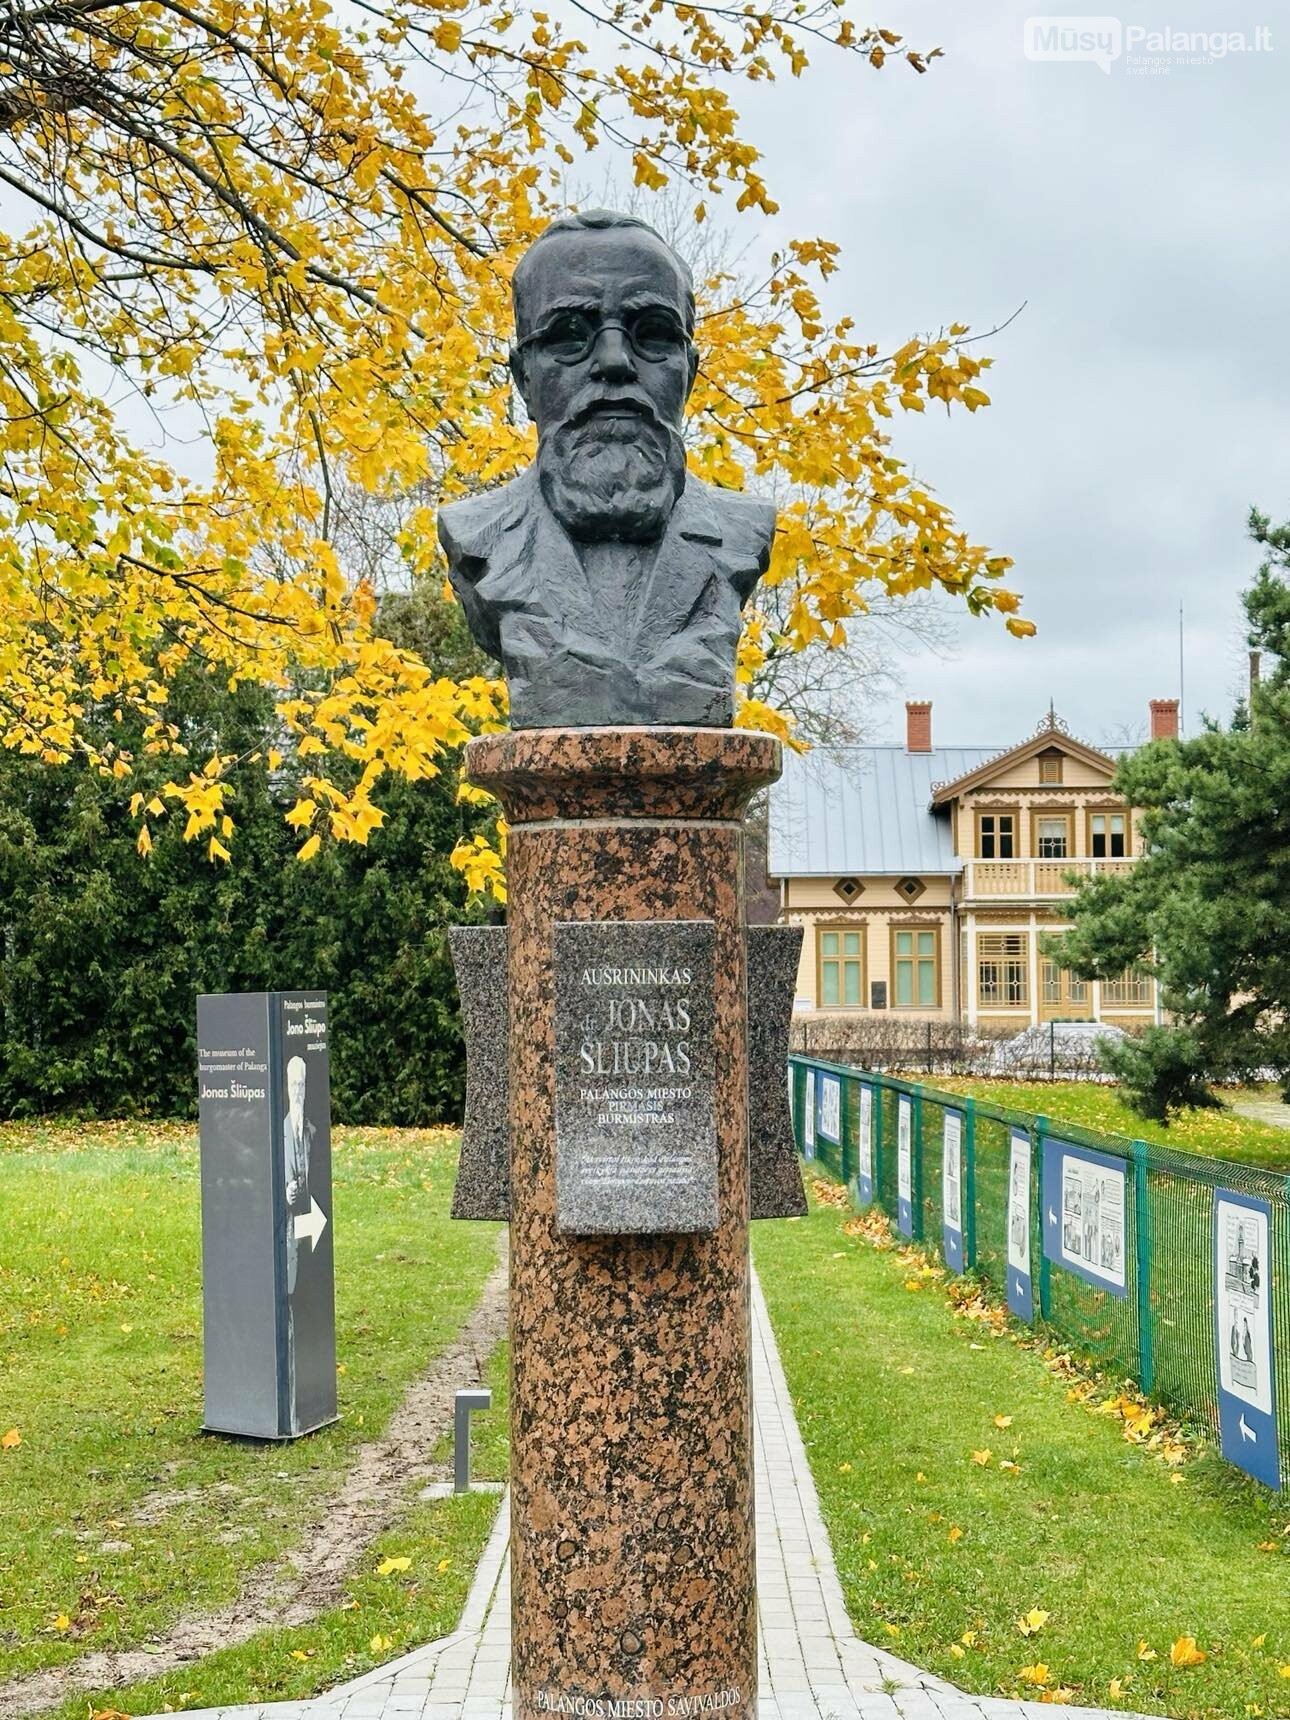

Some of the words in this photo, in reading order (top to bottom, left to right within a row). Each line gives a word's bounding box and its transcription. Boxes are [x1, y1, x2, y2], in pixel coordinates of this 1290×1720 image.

[605, 998, 691, 1031] JONAS
[287, 1020, 303, 1035] Jono
[200, 1048, 210, 1057] The
[212, 1049, 237, 1057] museum
[238, 1048, 245, 1057] of
[246, 1048, 256, 1057] the
[237, 1062, 244, 1071] of
[245, 1062, 267, 1073] Palanga
[201, 1084, 228, 1099] Jonas
[230, 1080, 265, 1103] Šliūpas
[580, 1088, 643, 1100] PALANGOS
[647, 1088, 692, 1099] MIESTO
[609, 1101, 664, 1112] PIRMASIS
[598, 1112, 675, 1124] BURMISTRAS
[537, 1689, 605, 1718] PALANGOS
[608, 1699, 663, 1718] MIESTO
